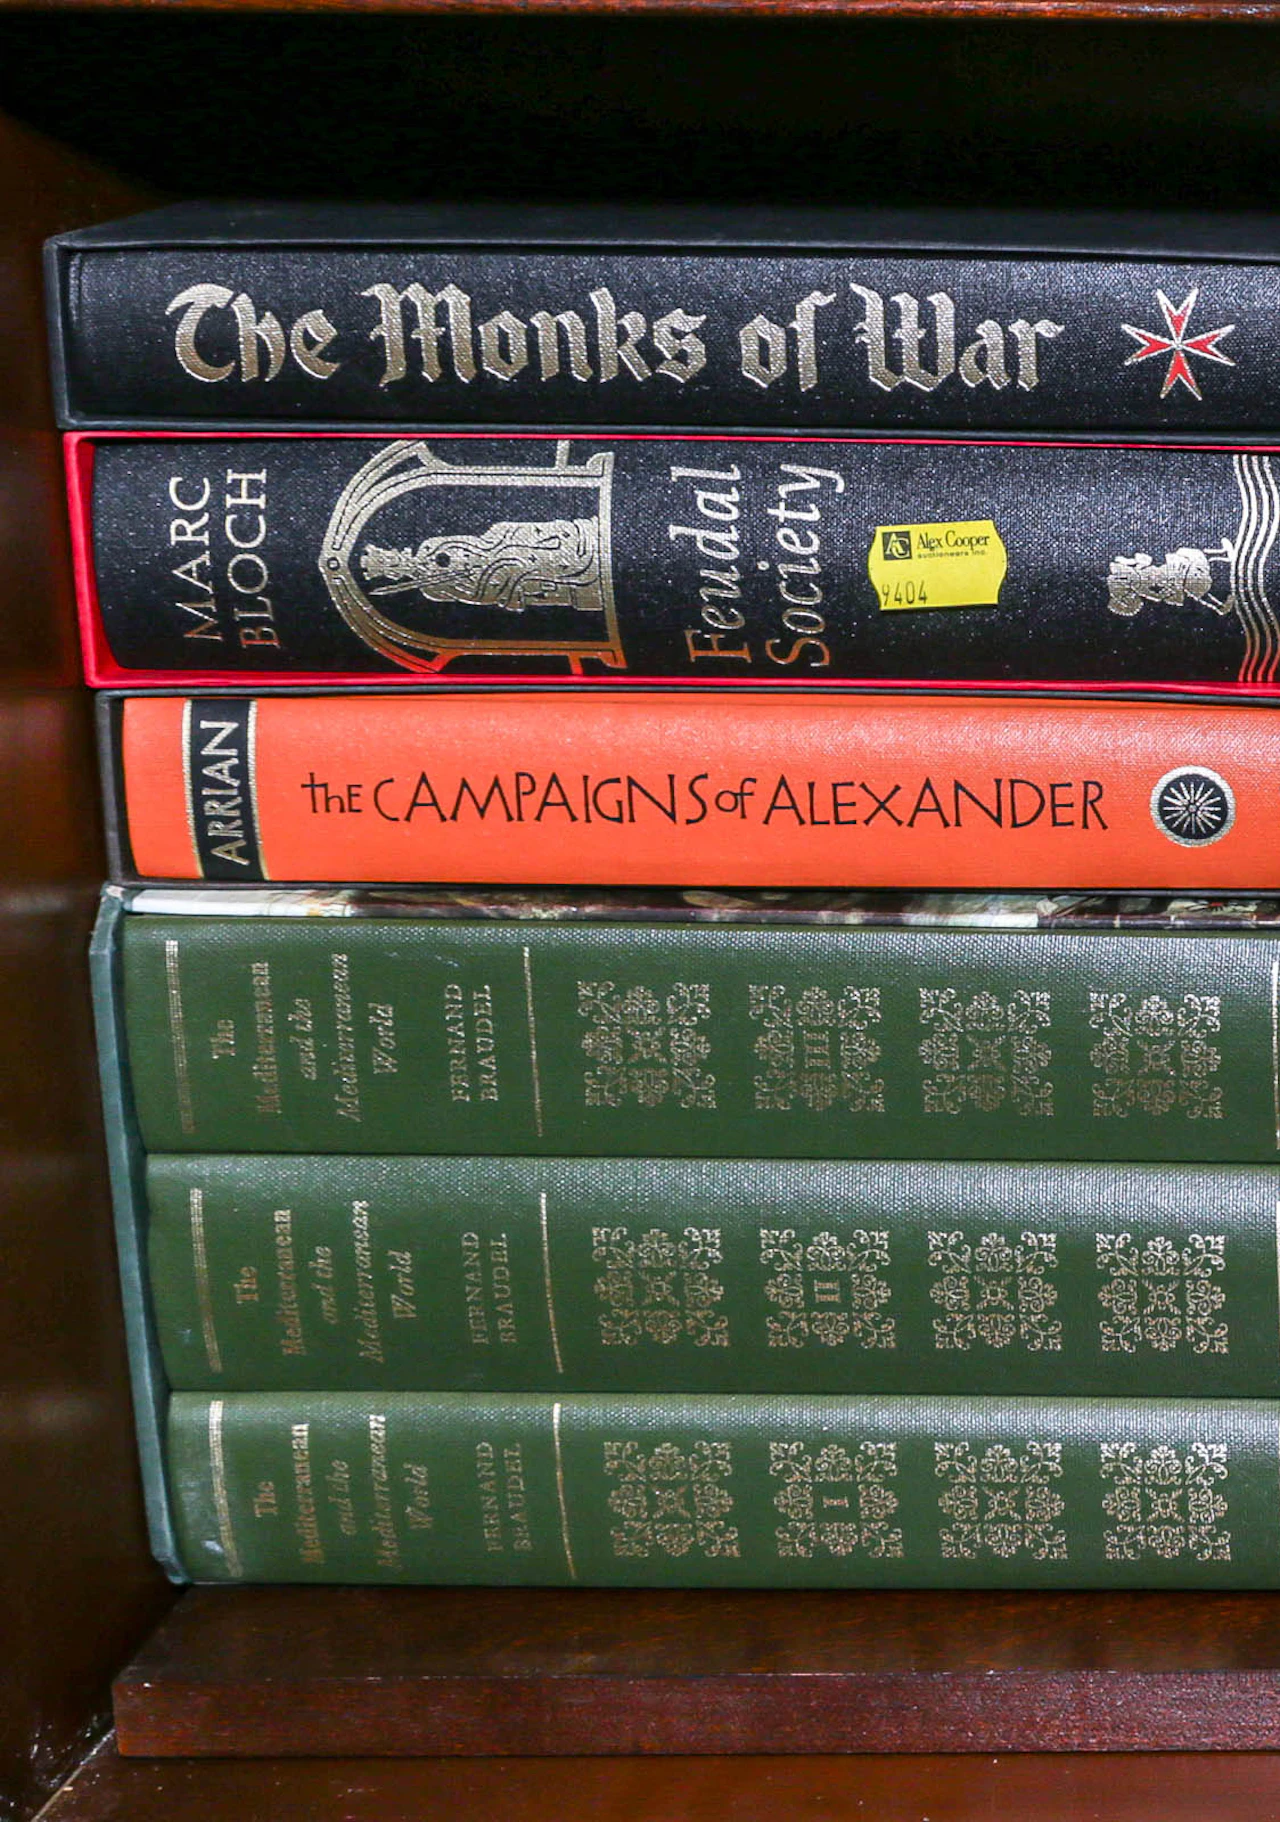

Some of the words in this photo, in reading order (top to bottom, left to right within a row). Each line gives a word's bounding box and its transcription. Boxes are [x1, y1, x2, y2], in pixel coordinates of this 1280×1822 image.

[165, 283, 341, 383] The
[361, 282, 706, 385] Monks
[738, 290, 836, 392] of
[850, 283, 1064, 393] War
[169, 477, 222, 643] MARC
[223, 468, 279, 649] BLOCH
[670, 464, 752, 663] Feudal
[765, 464, 844, 667] Society
[917, 532, 943, 551] Alex
[945, 530, 990, 550] Cooper
[881, 581, 928, 606] 9404
[200, 720, 249, 866] ARRIAN
[373, 771, 708, 825] CAMPAIGNS
[715, 777, 757, 816] of
[764, 776, 1108, 831] ALEXANDER
[211, 1019, 236, 1059] The
[288, 998, 312, 1032] the
[369, 1002, 398, 1074] World
[444, 983, 470, 1101] FERNAND
[474, 985, 499, 1101] BRAUDEL
[290, 1036, 316, 1080] and
[234, 1266, 259, 1304] The
[309, 1245, 332, 1279] the
[388, 1250, 417, 1319] World
[461, 1232, 489, 1345] FERNAND
[491, 1233, 517, 1344] BRAUDEL
[311, 1282, 337, 1325] and
[253, 1480, 278, 1518] The
[325, 1459, 349, 1494] the
[403, 1462, 433, 1530] World
[475, 1441, 503, 1551] FERNAND
[328, 1496, 355, 1536] and
